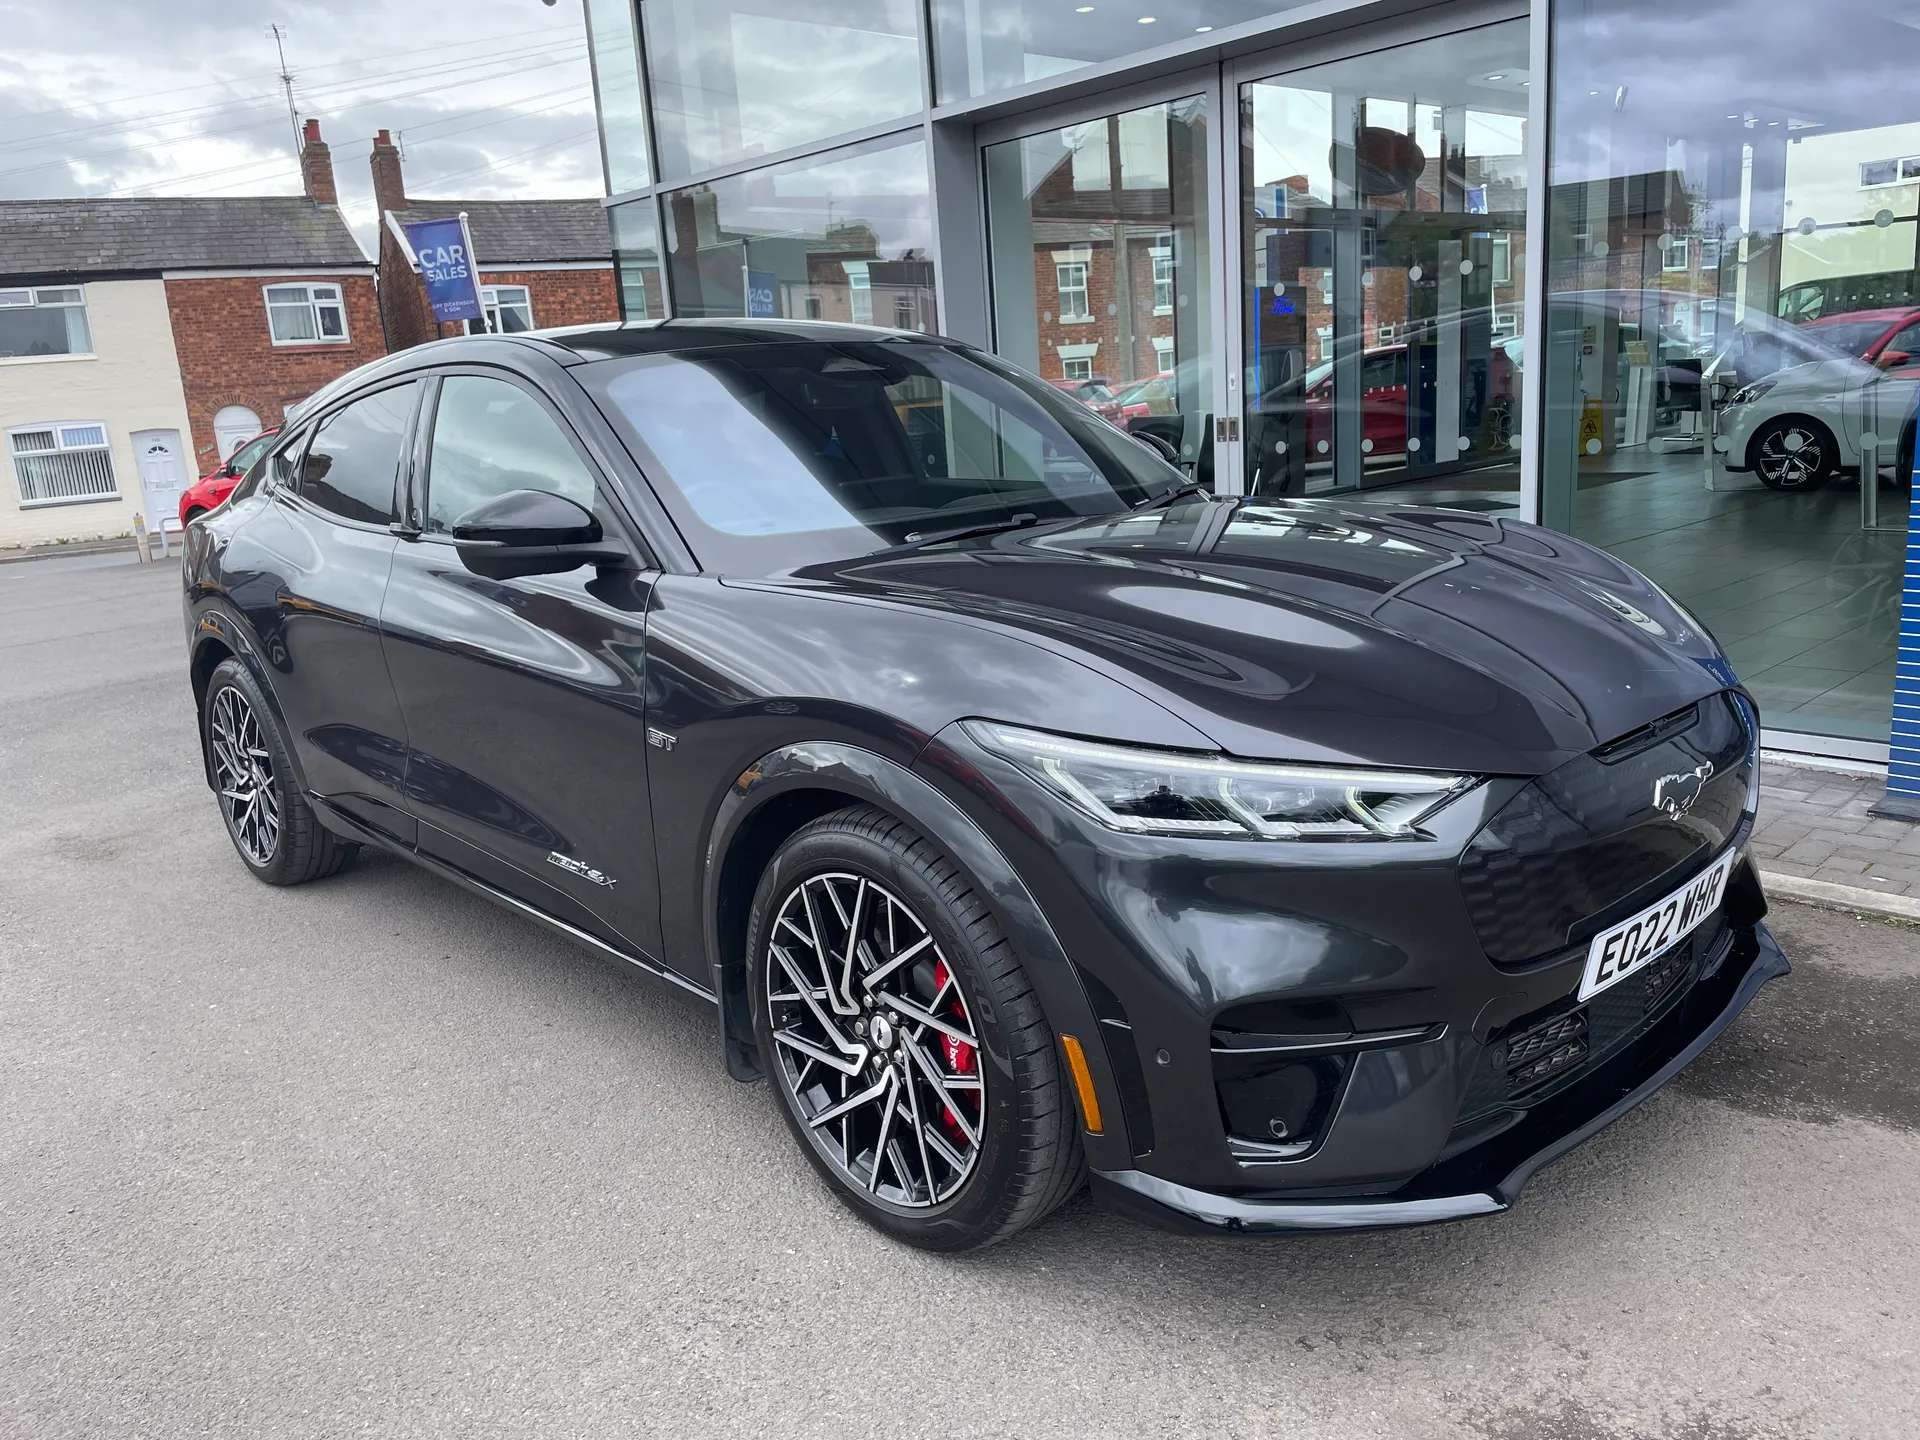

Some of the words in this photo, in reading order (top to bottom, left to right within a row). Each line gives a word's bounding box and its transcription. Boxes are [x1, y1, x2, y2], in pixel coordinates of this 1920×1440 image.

[418, 244, 465, 269] CAR
[427, 265, 468, 282] SALES
[647, 727, 677, 751] GT
[1594, 900, 1678, 986] EO22
[1676, 864, 1724, 935] WHR
